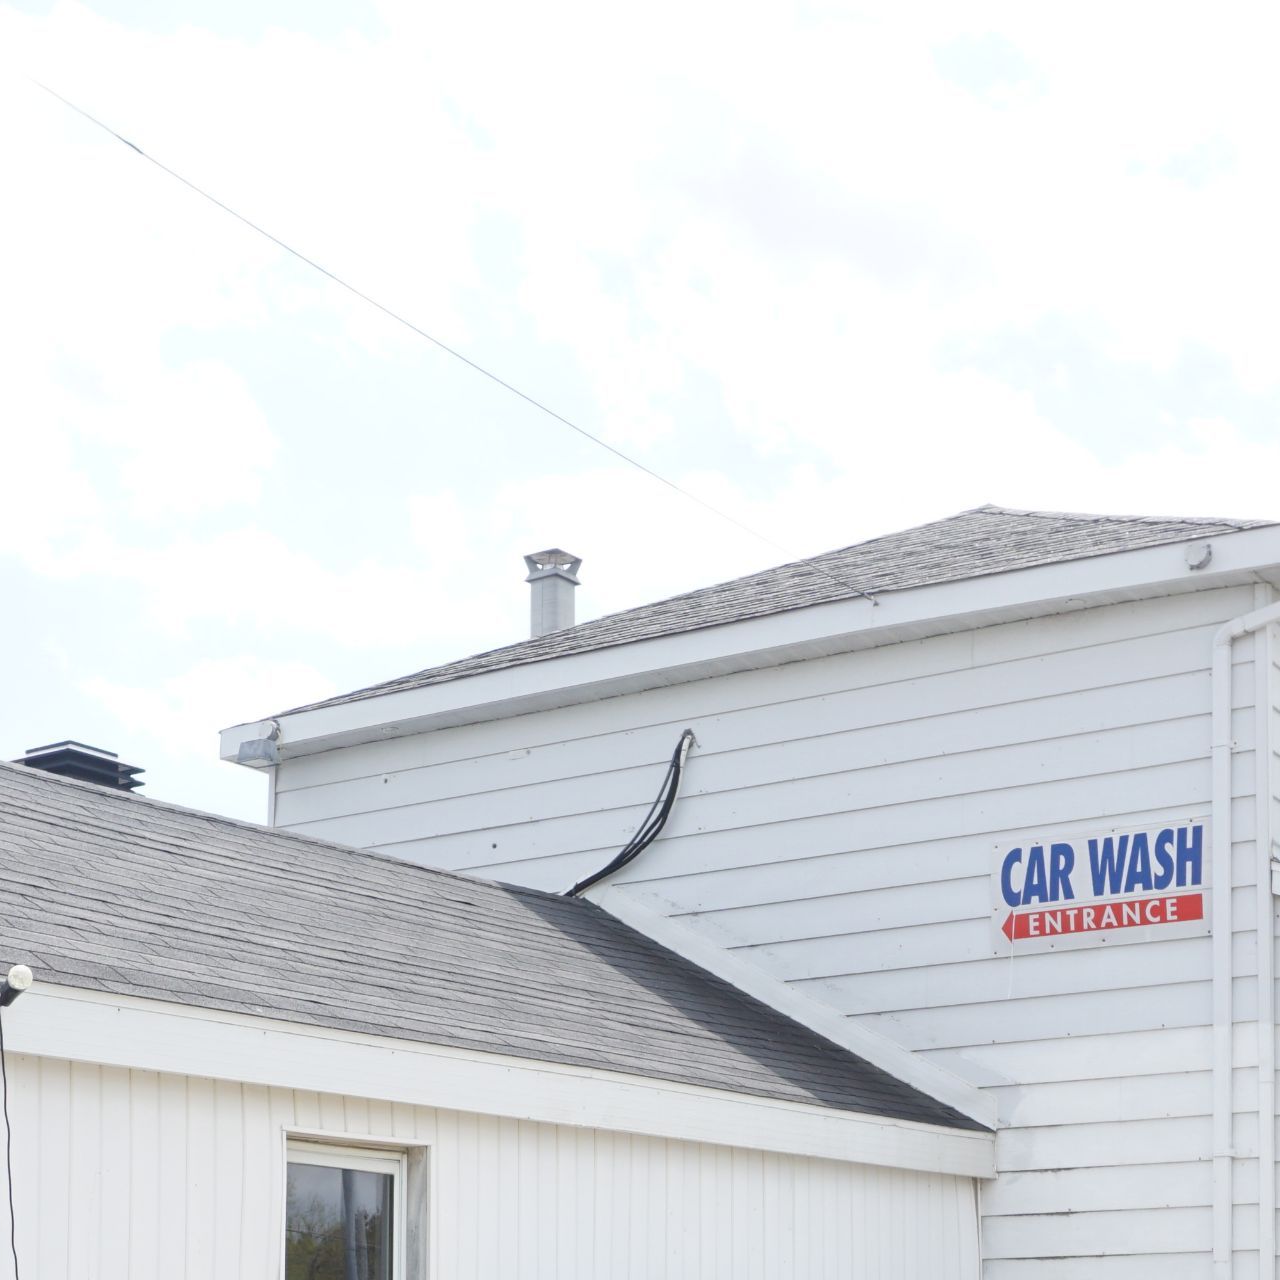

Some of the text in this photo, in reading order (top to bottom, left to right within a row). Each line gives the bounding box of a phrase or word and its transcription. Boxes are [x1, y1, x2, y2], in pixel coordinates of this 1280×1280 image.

[1001, 825, 1203, 907] CAR WASH
[1028, 898, 1178, 936] ENTRANCE
